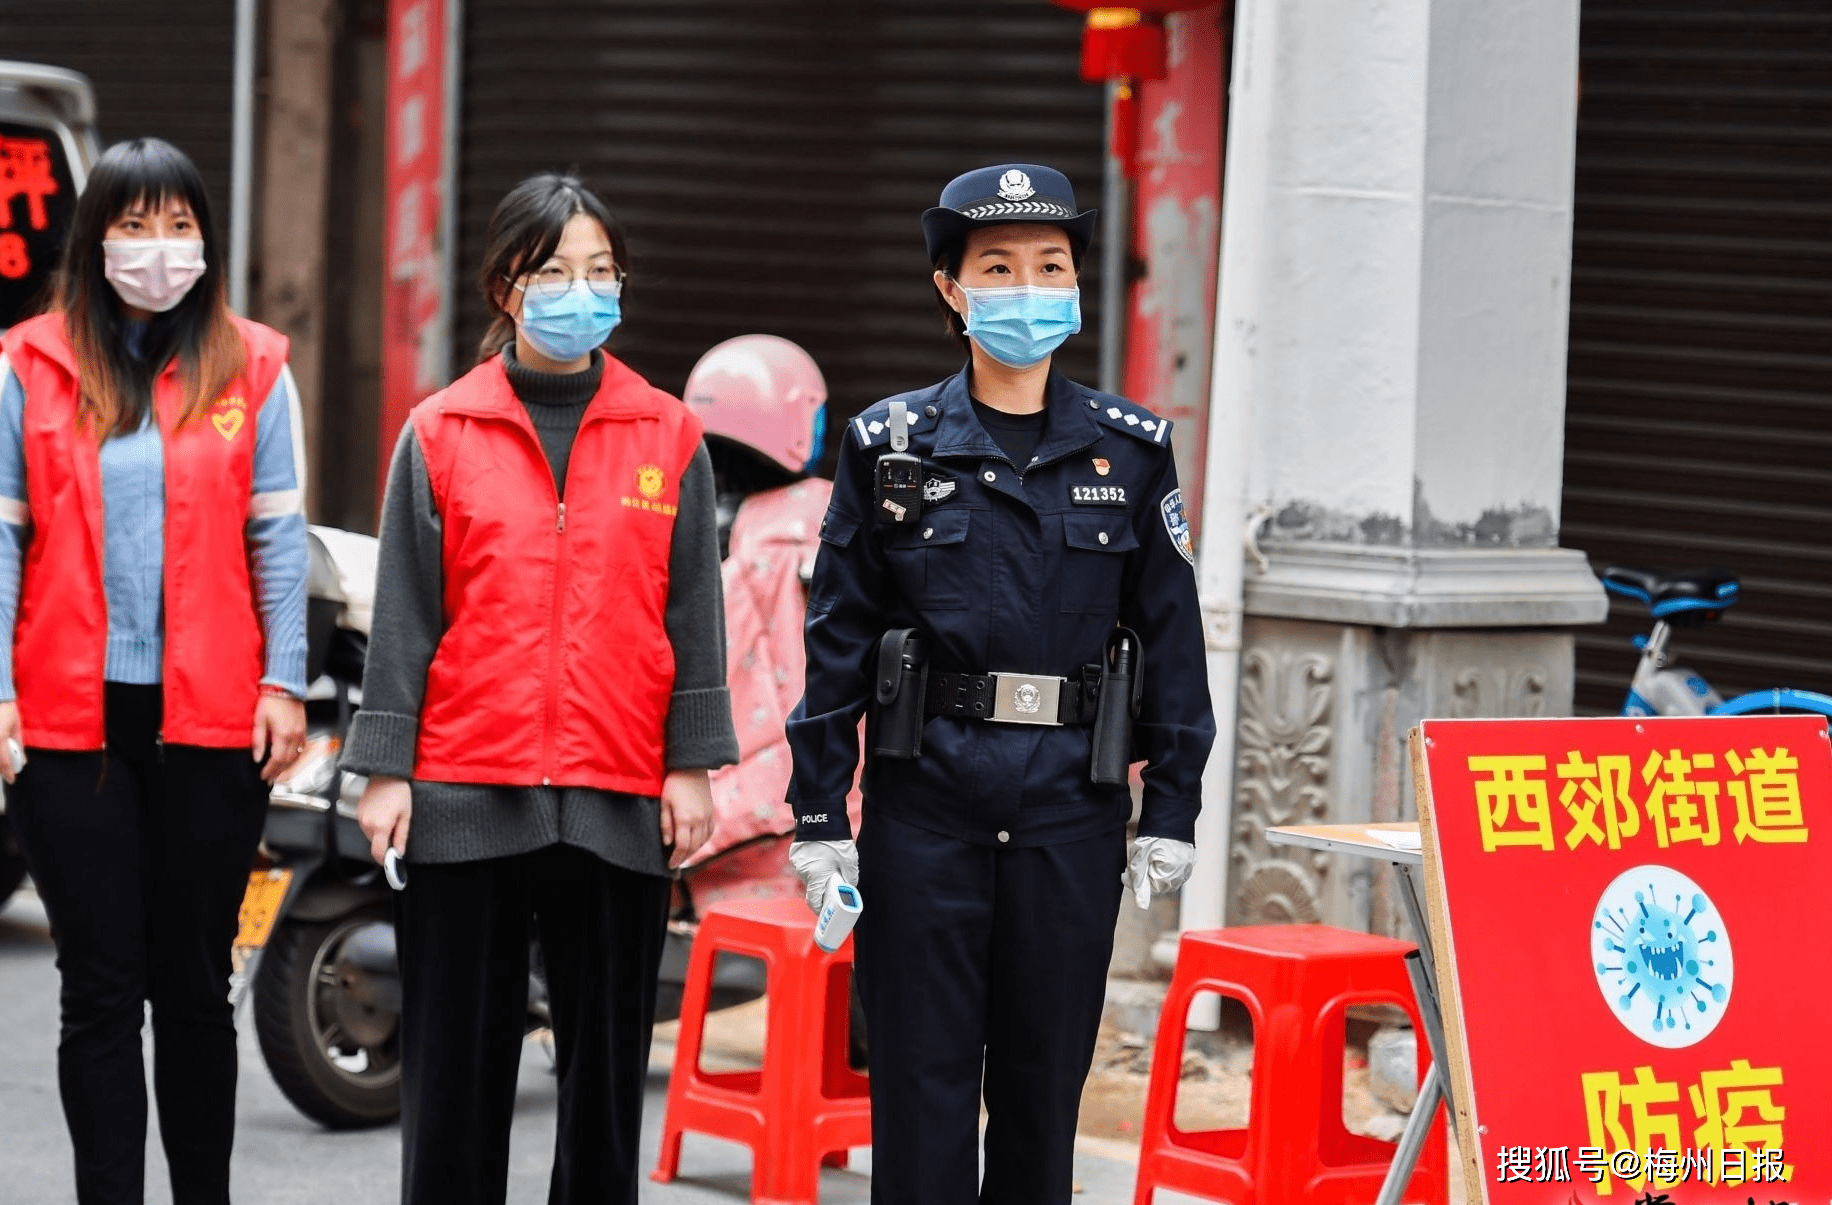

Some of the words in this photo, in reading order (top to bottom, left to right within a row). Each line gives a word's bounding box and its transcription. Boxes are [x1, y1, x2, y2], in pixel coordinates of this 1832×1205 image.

[1073, 487, 1126, 502] 121352
[801, 813, 829, 825] POLICE
[1468, 747, 1809, 852] 西郊街道
[1581, 1059, 1794, 1196] 防疫
